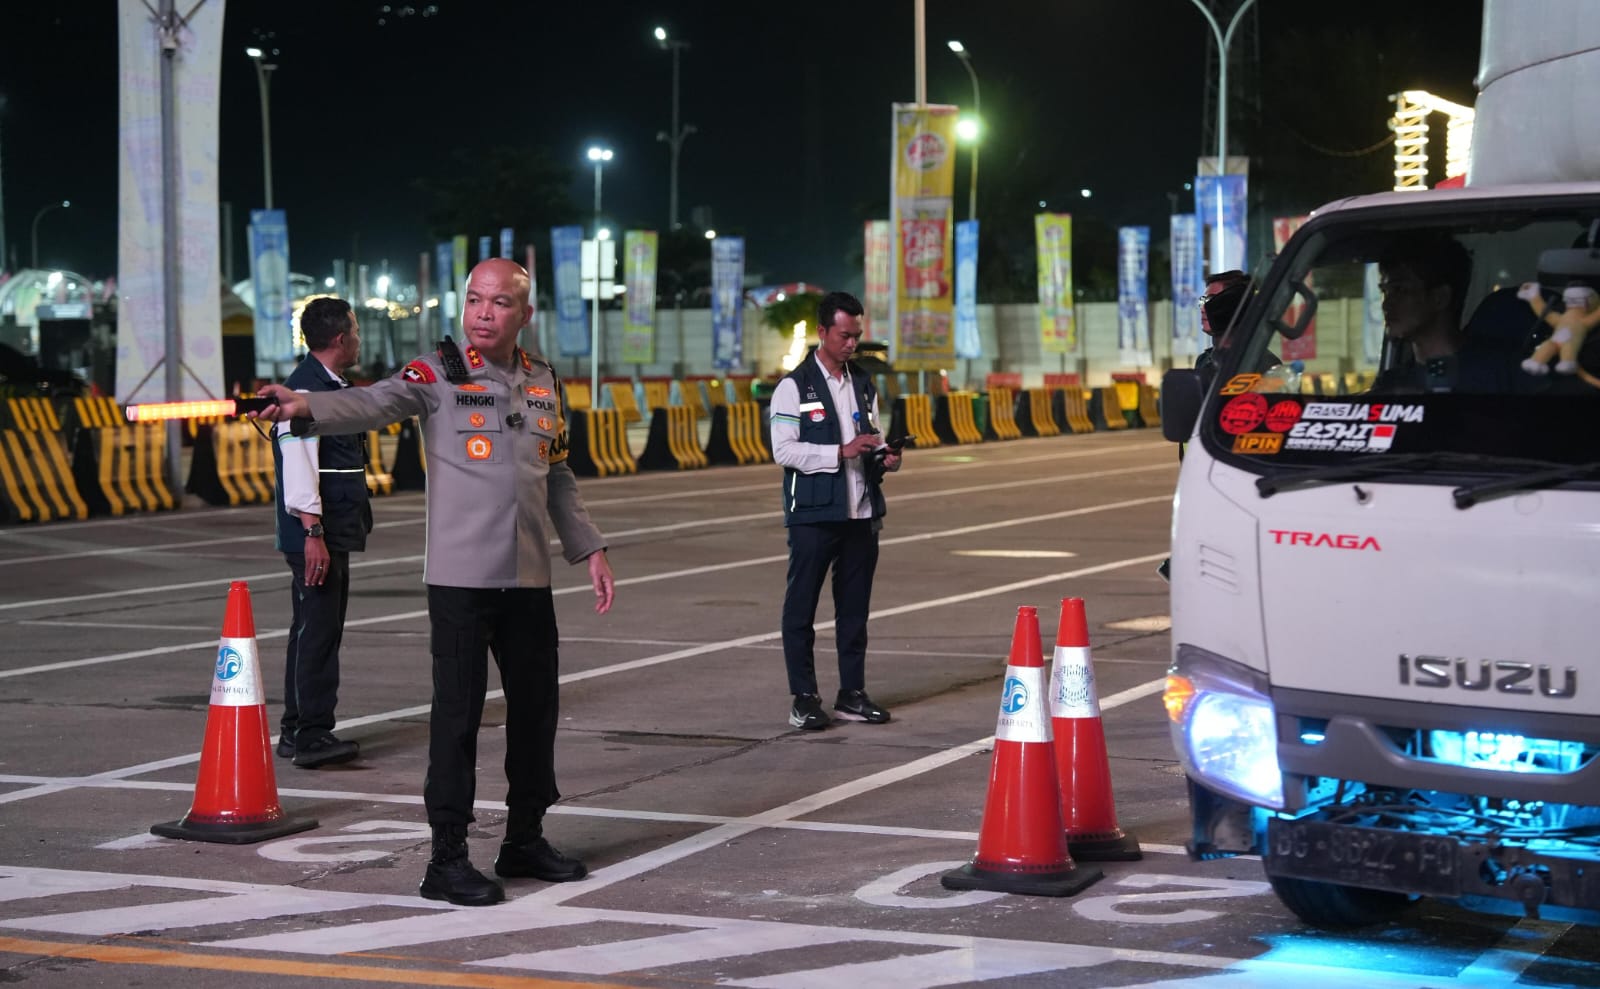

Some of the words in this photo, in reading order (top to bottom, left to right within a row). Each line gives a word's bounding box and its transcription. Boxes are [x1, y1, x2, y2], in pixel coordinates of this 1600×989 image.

[456, 395, 495, 407] HENGKI
[526, 400, 556, 411] POLRI
[1240, 438, 1279, 449] IPIN
[1268, 530, 1382, 551] TRAGA
[1399, 653, 1578, 699] ISUZU
